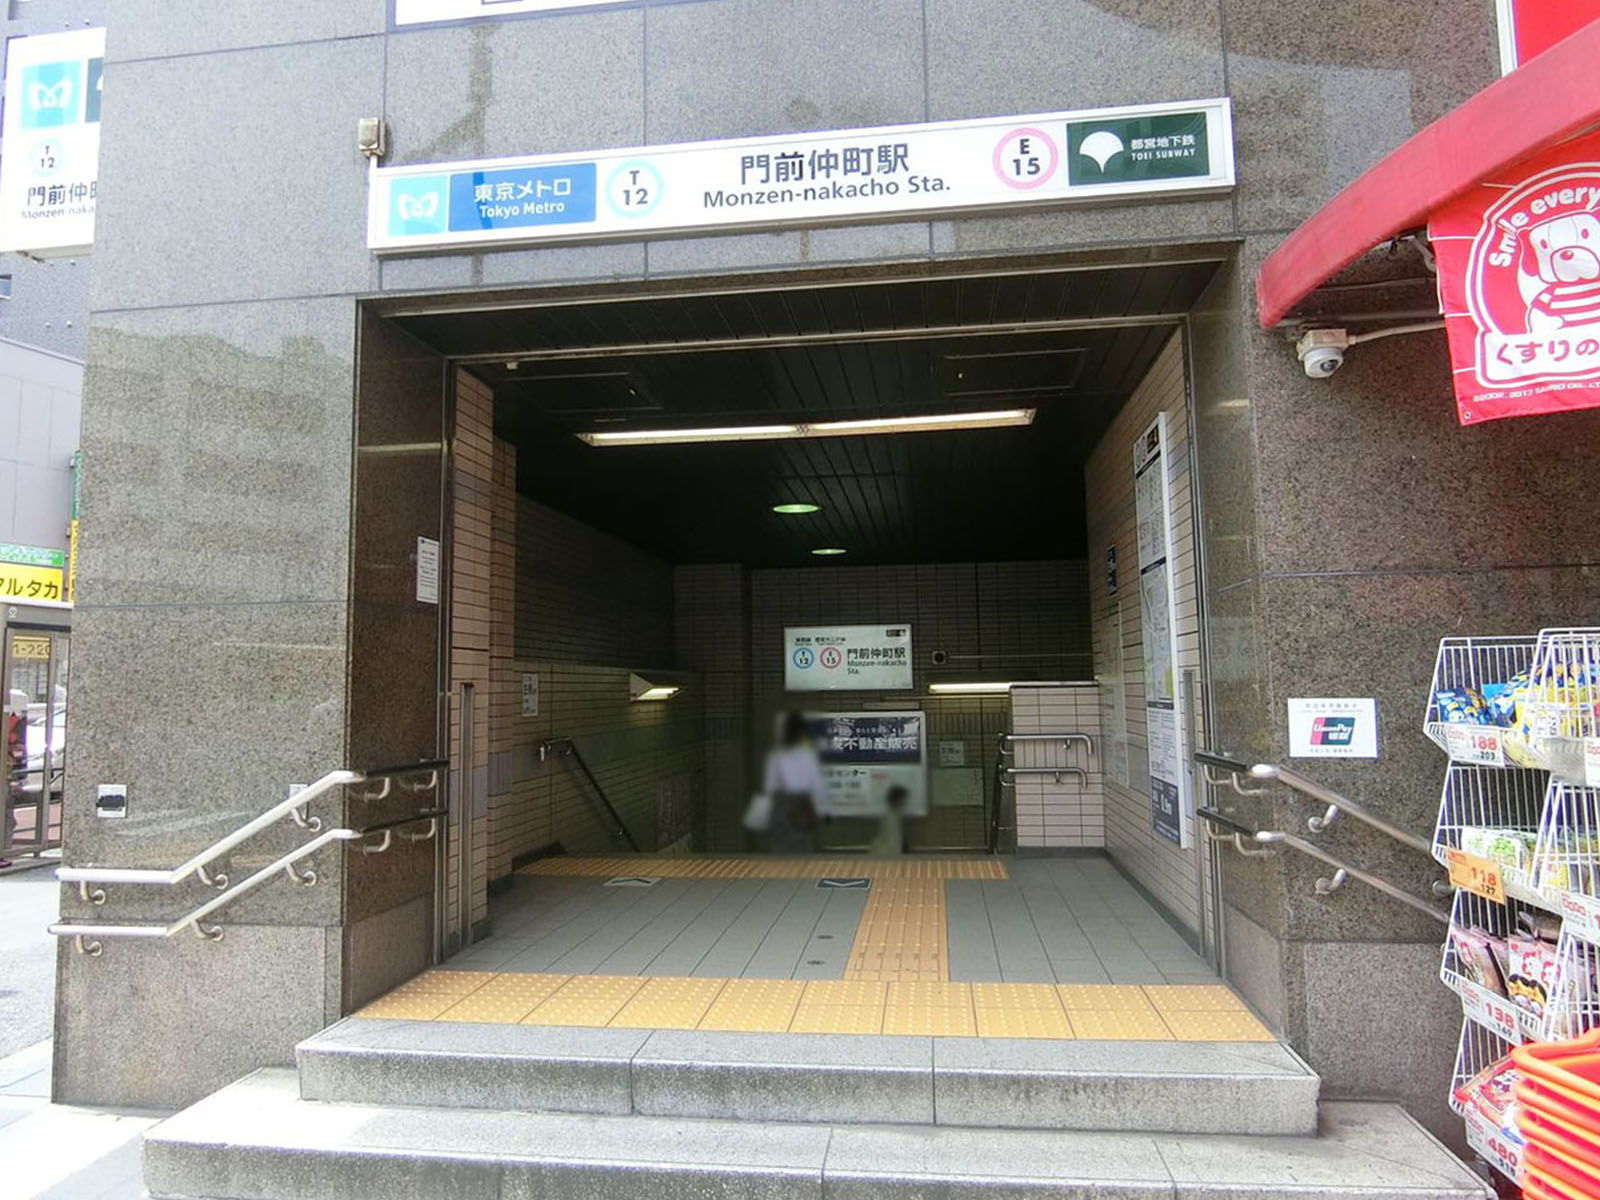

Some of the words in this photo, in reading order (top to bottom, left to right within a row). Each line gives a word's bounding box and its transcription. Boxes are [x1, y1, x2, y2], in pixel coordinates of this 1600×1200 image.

[1019, 138, 1030, 154] E
[1131, 134, 1196, 150] 都営地下鉄
[41, 157, 55, 168] 12
[1131, 151, 1152, 161] TOEI
[1156, 148, 1196, 160] SUBWAY
[741, 143, 909, 185] 門前仲町駅
[1013, 157, 1041, 176] 15
[629, 170, 640, 185] T
[473, 178, 571, 203] 東京メトロ
[623, 188, 648, 206] 12
[703, 178, 900, 208] Monzen-nakacho
[908, 175, 951, 194] Sta.
[480, 204, 520, 220] Tokyo
[523, 202, 565, 215] Metro
[1471, 735, 1498, 750] 188
[1471, 866, 1497, 886] 118
[1485, 1002, 1514, 1030] 138
[1488, 1137, 1518, 1167] 480
